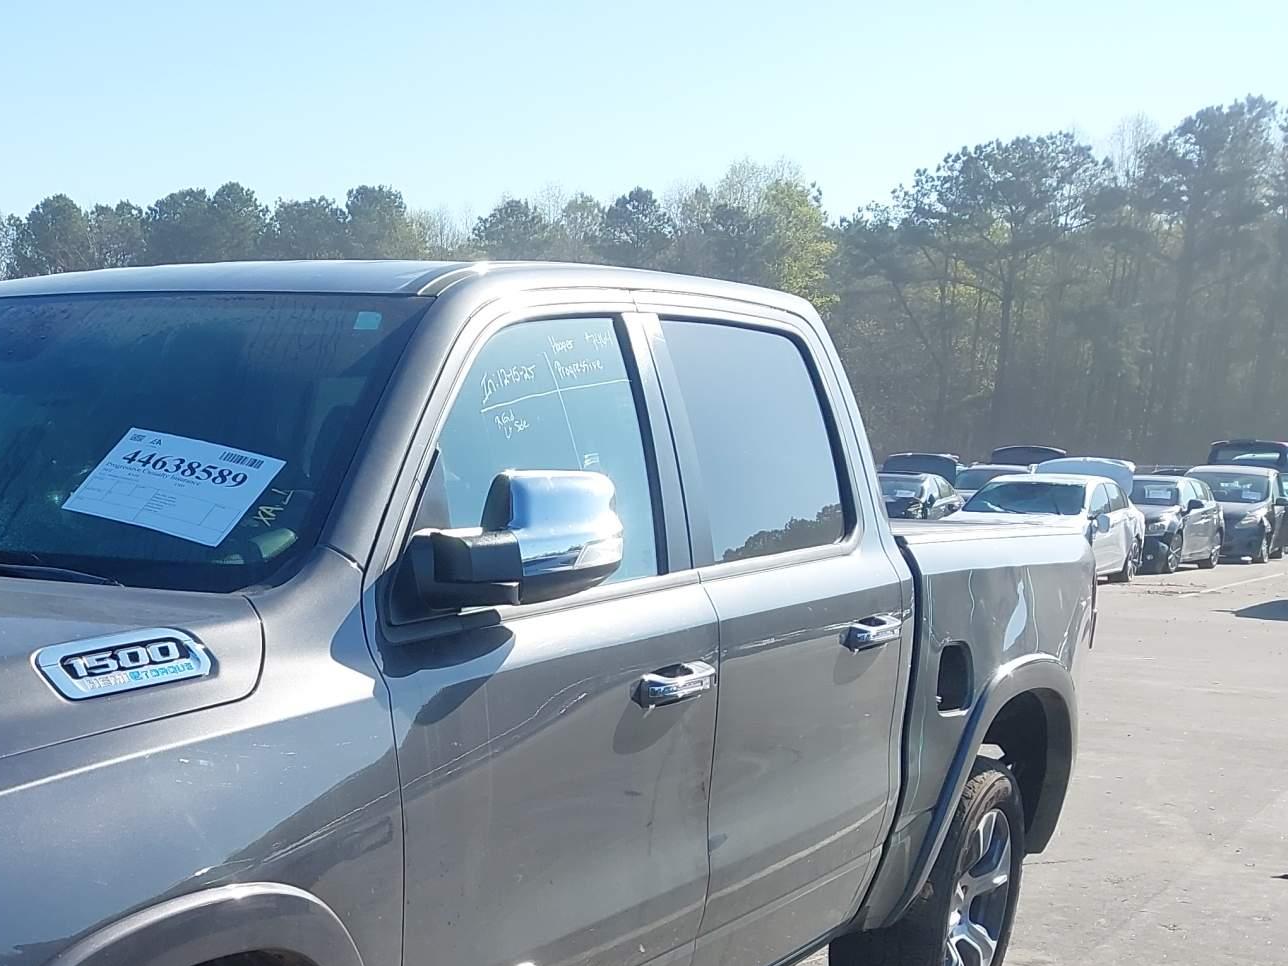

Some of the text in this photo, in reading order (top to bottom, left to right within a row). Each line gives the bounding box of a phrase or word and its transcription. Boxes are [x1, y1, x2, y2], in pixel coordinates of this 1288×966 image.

[122, 449, 249, 488] 44638589
[63, 641, 180, 677] 1500
[85, 674, 129, 690] HEMI
